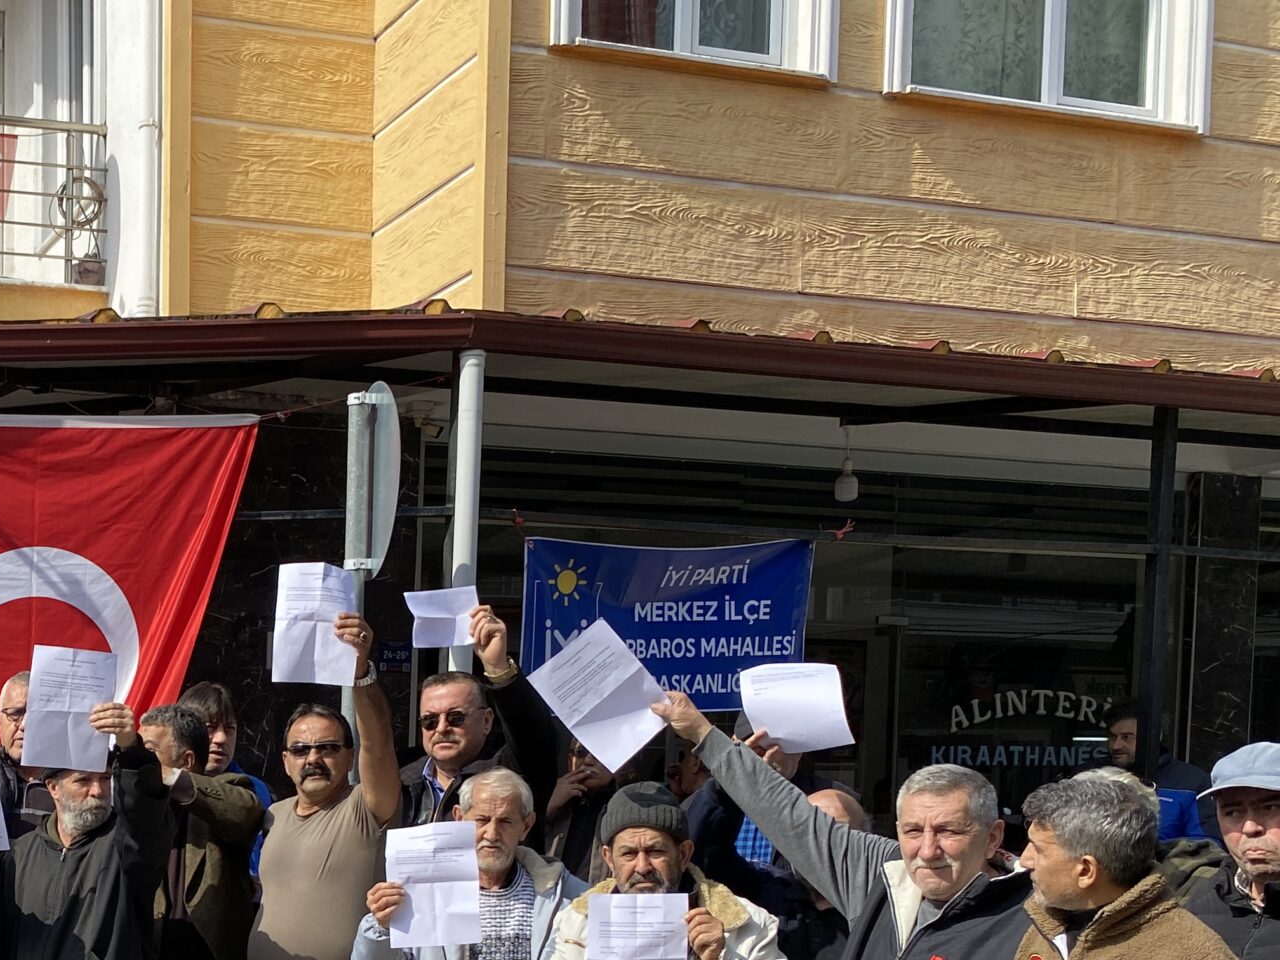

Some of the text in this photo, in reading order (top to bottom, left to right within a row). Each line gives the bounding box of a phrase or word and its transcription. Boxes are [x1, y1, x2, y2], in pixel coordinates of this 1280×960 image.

[660, 559, 750, 588] İYİ PARTİ
[634, 595, 772, 625] MERKEZ İLÇE
[625, 630, 796, 659] RBAROS MAHALLESİ
[931, 744, 1109, 767] KIRAATHANES
